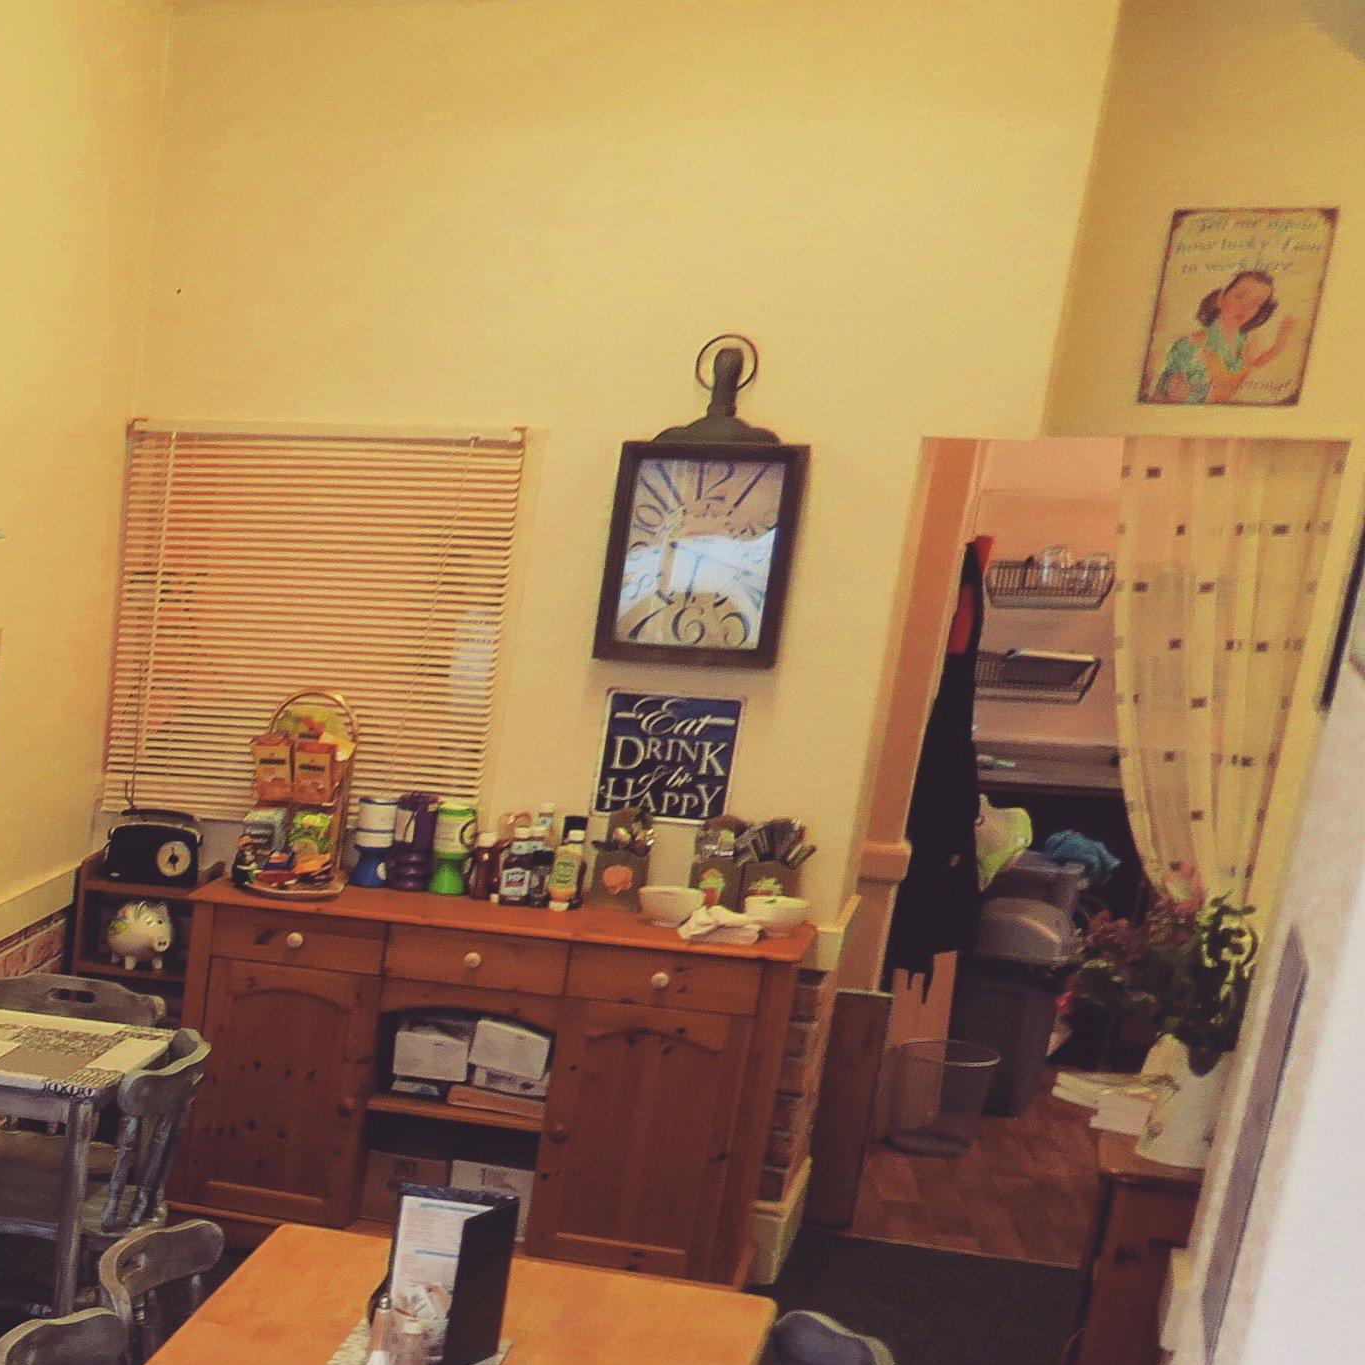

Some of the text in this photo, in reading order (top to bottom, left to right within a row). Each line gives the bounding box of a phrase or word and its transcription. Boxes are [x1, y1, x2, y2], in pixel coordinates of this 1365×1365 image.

[633, 697, 713, 737] Eat
[610, 735, 729, 777] DRINK
[601, 777, 724, 818] HAPPY
